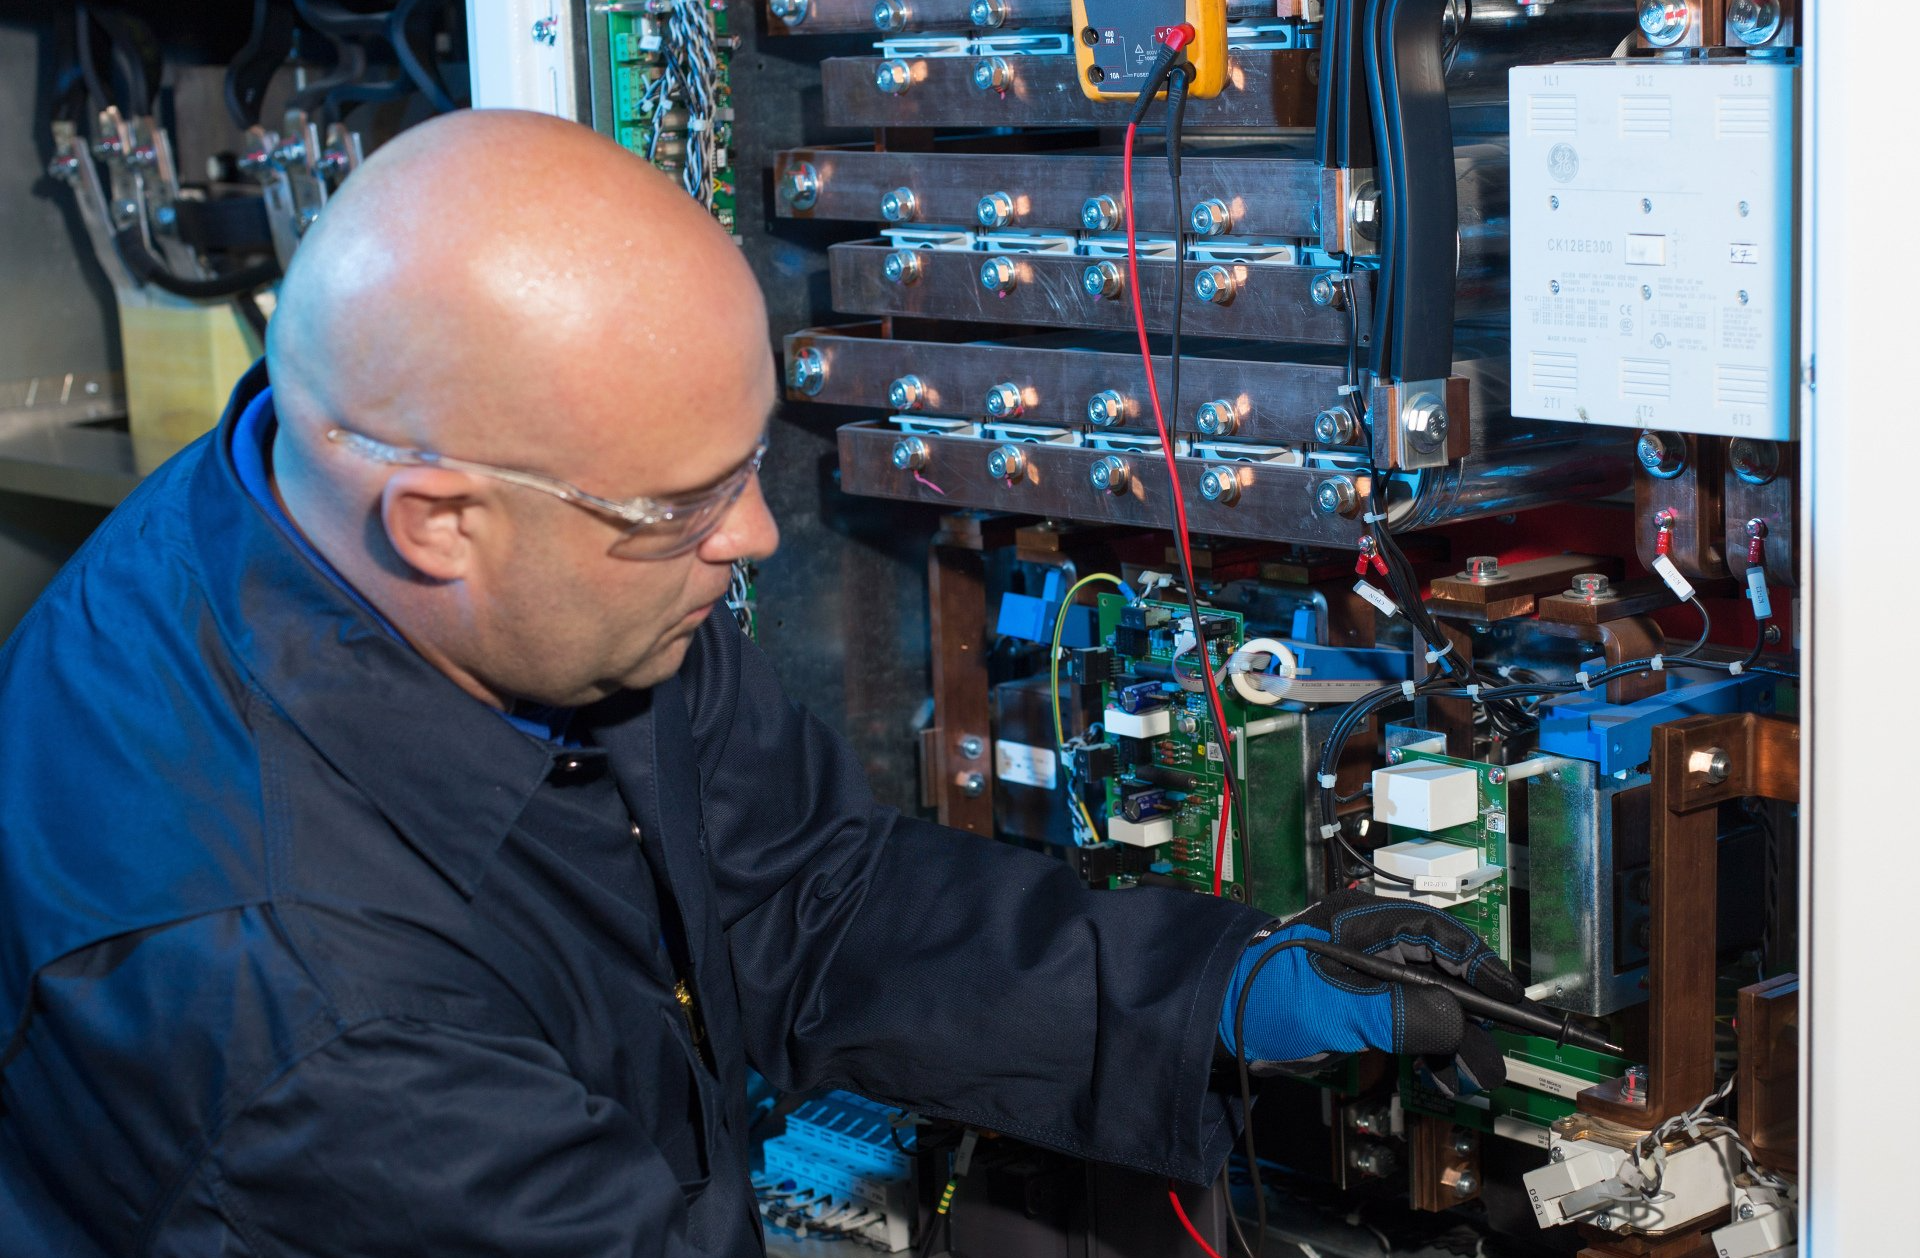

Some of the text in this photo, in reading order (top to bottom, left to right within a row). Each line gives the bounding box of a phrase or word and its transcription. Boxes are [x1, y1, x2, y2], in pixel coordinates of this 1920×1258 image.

[1104, 30, 1114, 38] 400
[1543, 75, 1560, 87] 1L1
[1635, 75, 1654, 87] 3L2
[1733, 75, 1753, 87] 5L3
[1547, 238, 1613, 254] CK12BE300
[1543, 397, 1561, 409] 2T1
[1635, 405, 1655, 418] 4T2
[1731, 413, 1752, 426] 6T3
[1489, 843, 1497, 863] BAR
[1491, 901, 1498, 909] A
[1491, 913, 1500, 942] 0046
[1529, 1188, 1543, 1216] 0941
